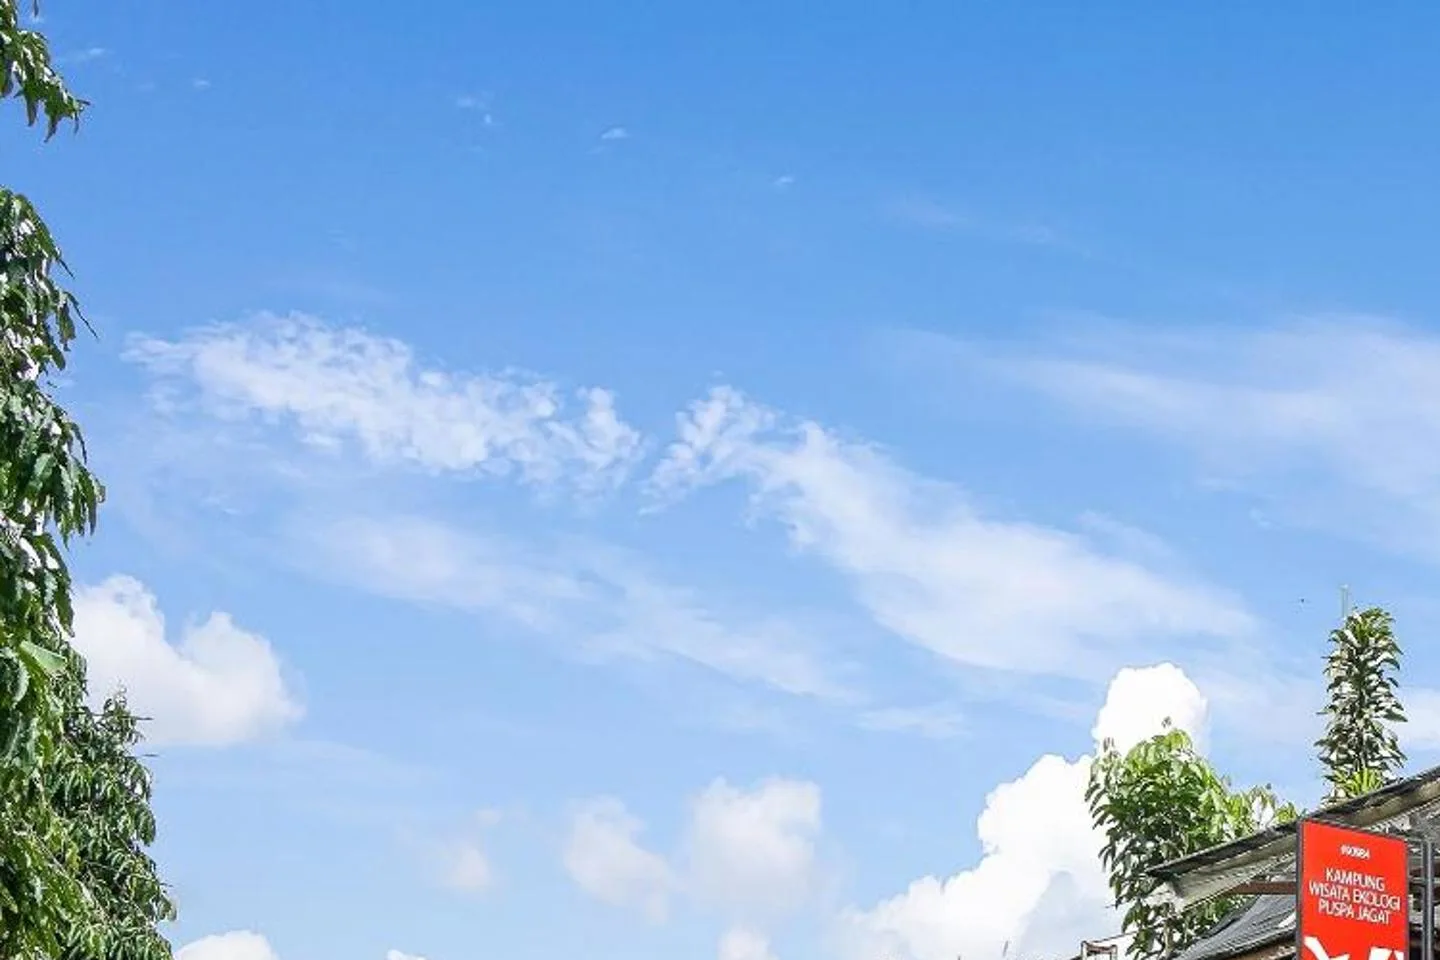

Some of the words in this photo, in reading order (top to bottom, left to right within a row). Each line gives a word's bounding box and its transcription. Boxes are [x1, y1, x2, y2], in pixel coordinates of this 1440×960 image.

[1325, 868, 1385, 891] KAMPUNG
[1309, 879, 1350, 902] WISATA
[1353, 889, 1401, 910] EKOLOGI
[1318, 898, 1354, 919] PUSPA
[1356, 907, 1391, 924] JAGAT
